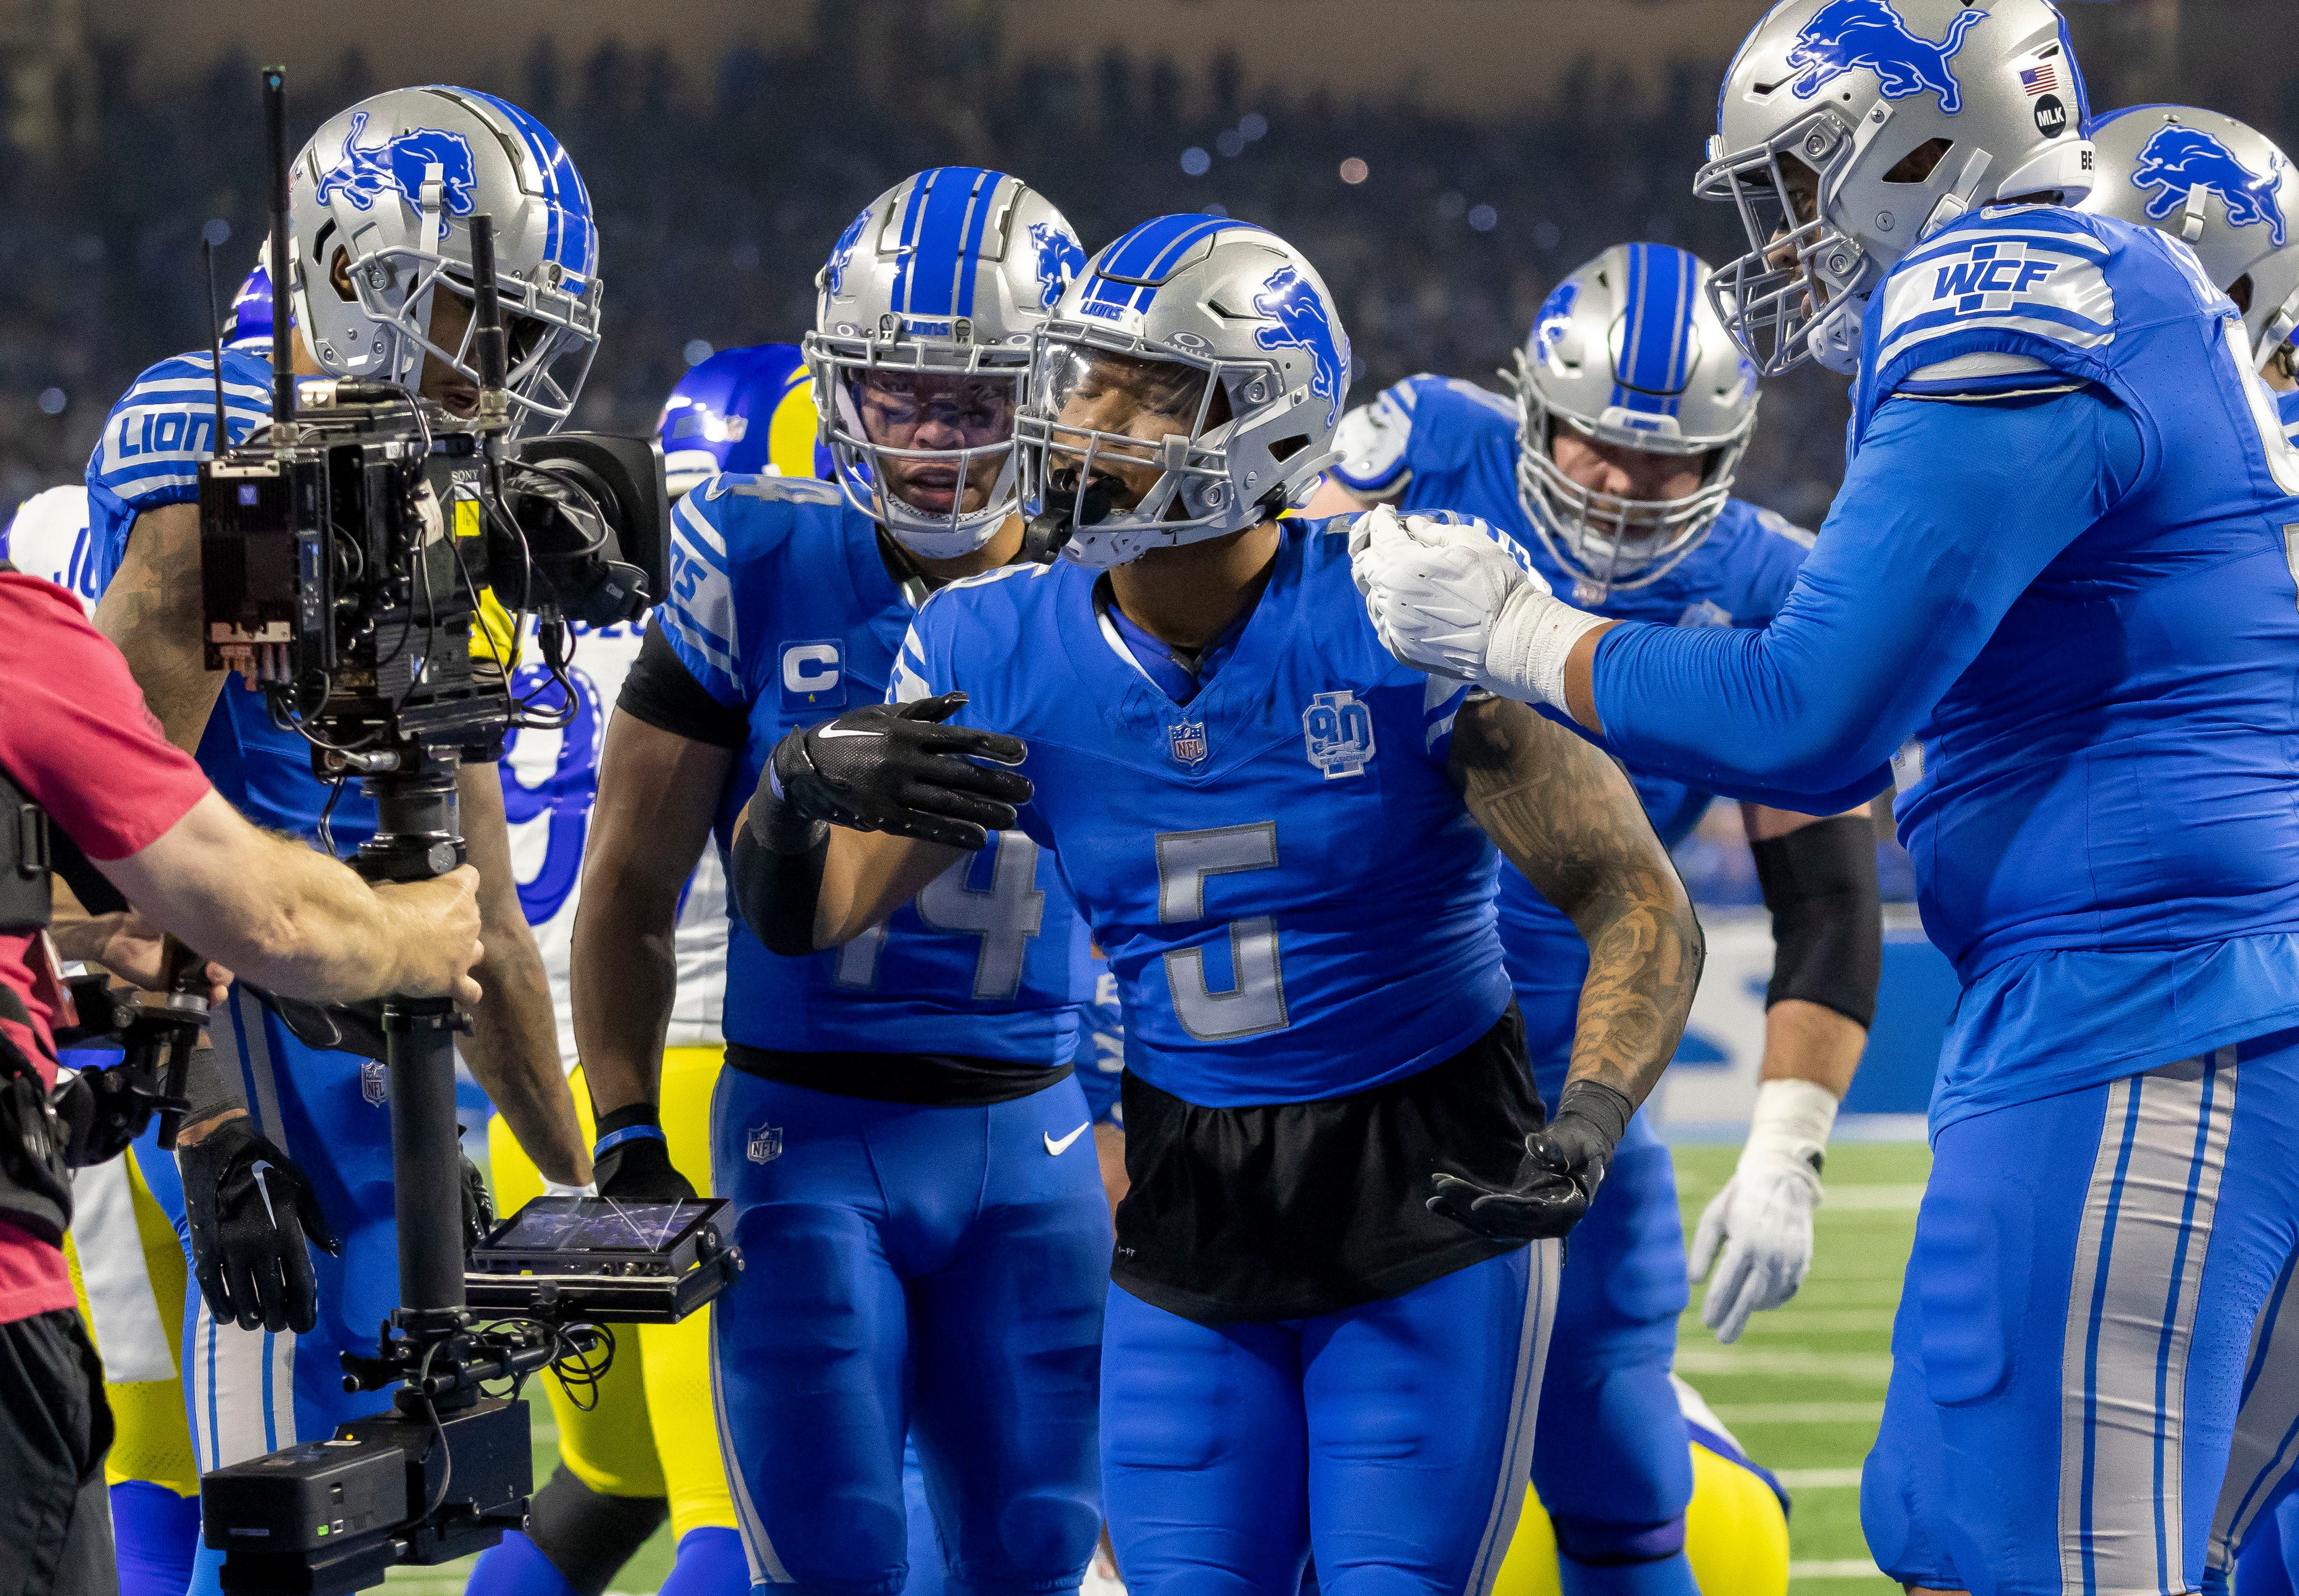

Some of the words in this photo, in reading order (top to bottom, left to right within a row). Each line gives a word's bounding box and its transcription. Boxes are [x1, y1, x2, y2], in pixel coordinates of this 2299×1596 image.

[2037, 107, 2065, 126] MLK
[1933, 260, 2058, 300] WCF
[1080, 301, 1125, 320] LIONS
[119, 411, 256, 459] LIONS
[451, 469, 478, 482] SONY
[783, 645, 839, 693] C
[1308, 705, 1371, 755] 90
[1176, 741, 1203, 759] NFL
[1155, 821, 1289, 1042] 5
[366, 1081, 385, 1098] NFL
[752, 1141, 776, 1157] NFL
